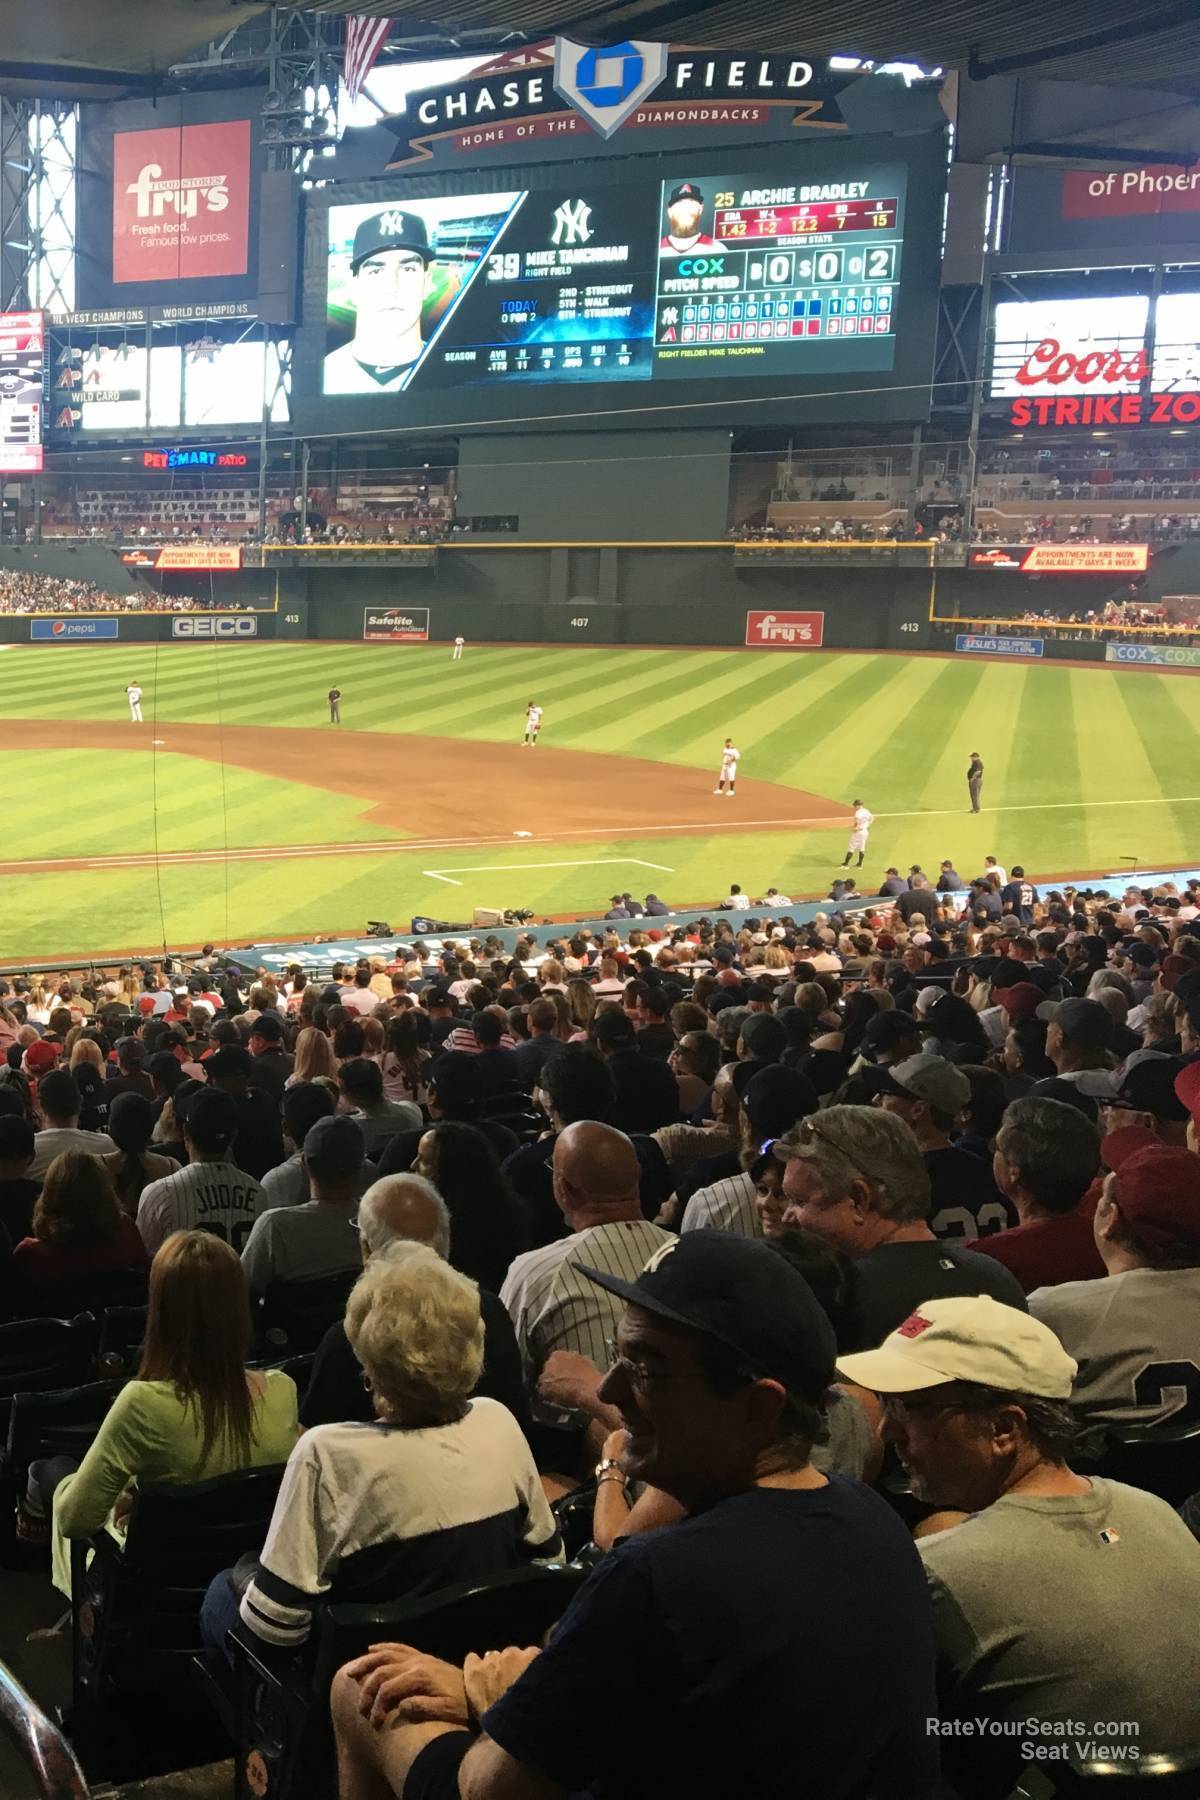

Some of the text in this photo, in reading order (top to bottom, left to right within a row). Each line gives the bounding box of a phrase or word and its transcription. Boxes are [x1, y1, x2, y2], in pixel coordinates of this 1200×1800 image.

[418, 61, 812, 124] CHASE FIELD
[462, 109, 760, 145] HOME OF THE DIAMONDBACKS
[152, 177, 222, 190] FOOD STORES
[1089, 173, 1117, 196] of
[126, 164, 229, 218] fry's
[714, 182, 869, 207] 25 ARCHIE BRADLEY
[724, 212, 741, 221] ERA
[760, 210, 775, 218] W-L
[876, 202, 883, 211] K
[132, 222, 189, 235] Fresh food.
[721, 214, 887, 236] 1.42 1-2 12.2 7 15
[141, 232, 231, 248] Famous low prices.
[808, 235, 832, 244] STATS
[488, 253, 520, 280] 39
[525, 250, 556, 266] MIKE
[525, 266, 572, 277] RIGHT FIELD
[678, 258, 725, 275] COX
[751, 250, 888, 281] B 0 S 0 2
[559, 284, 633, 297] 2ND STRIKEOUT
[664, 276, 739, 292] PITCH SPEED
[500, 300, 538, 312] TODAY
[559, 297, 610, 308] 5TH WALK
[93, 310, 144, 322] CHAMPIONS
[163, 304, 248, 318] WORLD CHAMPIONS
[584, 307, 632, 318] STRIKEOUT
[502, 314, 508, 323] 0
[530, 313, 536, 322] 2
[700, 316, 887, 338] 2 4
[444, 352, 476, 361] SEASON
[565, 347, 581, 356] OPS
[658, 350, 680, 358] RIGHT
[680, 349, 708, 357] FIELDER
[709, 348, 726, 356] MIKE
[517, 360, 527, 369] 11
[1014, 338, 1149, 386] Coors
[72, 391, 119, 402] WILD CARD
[1010, 396, 1142, 426] STRIKE
[218, 456, 246, 465] PATIO
[285, 614, 299, 623] 413
[368, 616, 413, 625] Safelite
[571, 617, 588, 627] 407
[66, 623, 96, 635] pepsi
[174, 618, 255, 635] GEICO
[756, 615, 813, 642] fry's
[900, 622, 919, 632] 413
[1118, 647, 1147, 660] COX
[1166, 650, 1196, 663] COX
[196, 1184, 258, 1214] JUDGE
